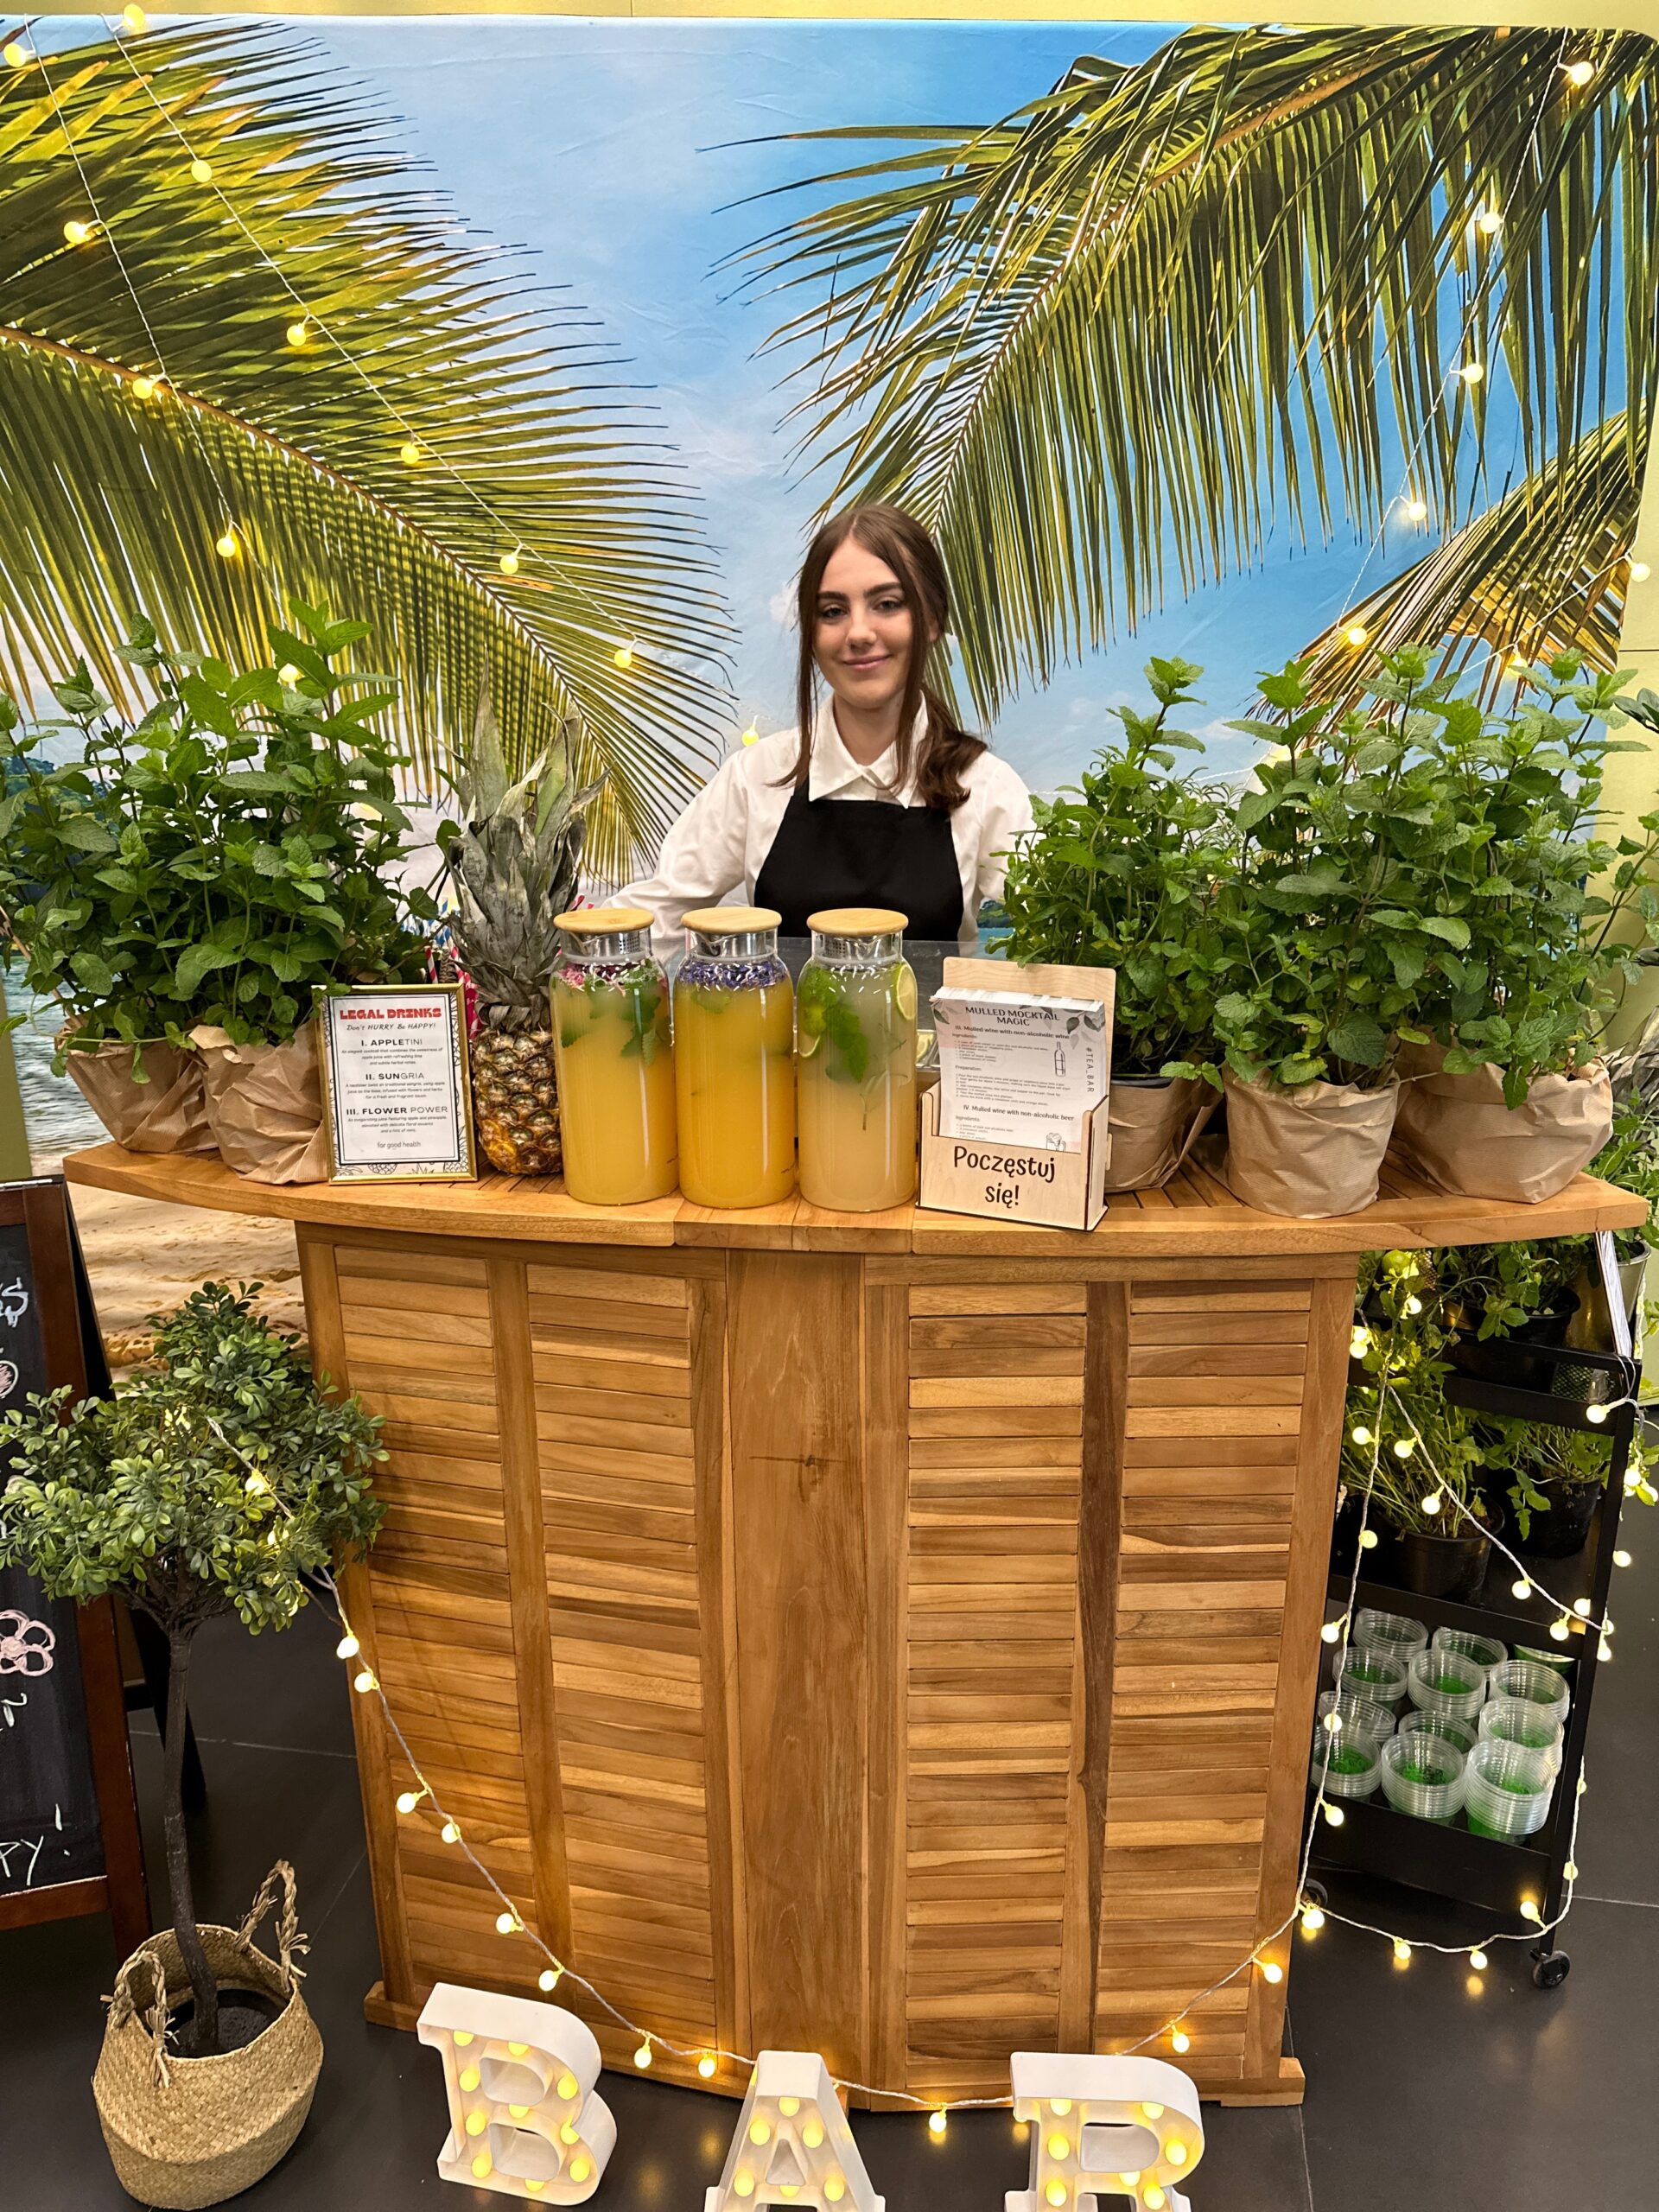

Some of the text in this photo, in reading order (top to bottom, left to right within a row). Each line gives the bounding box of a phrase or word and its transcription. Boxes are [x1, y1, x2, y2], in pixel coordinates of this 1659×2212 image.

[340, 1007, 442, 1020] LEGAL DRINKS
[965, 1007, 1060, 1021] MULLED MOCKTAIL
[997, 1017, 1030, 1026] MAGIC
[1013, 1030, 1054, 1039] non-alcoholic
[1085, 1047, 1094, 1093] #TEA_BAR
[1020, 1110, 1059, 1120] non-alcoholic
[954, 1145, 1055, 1183] Poczęstuj
[985, 1182, 1020, 1209] się!
